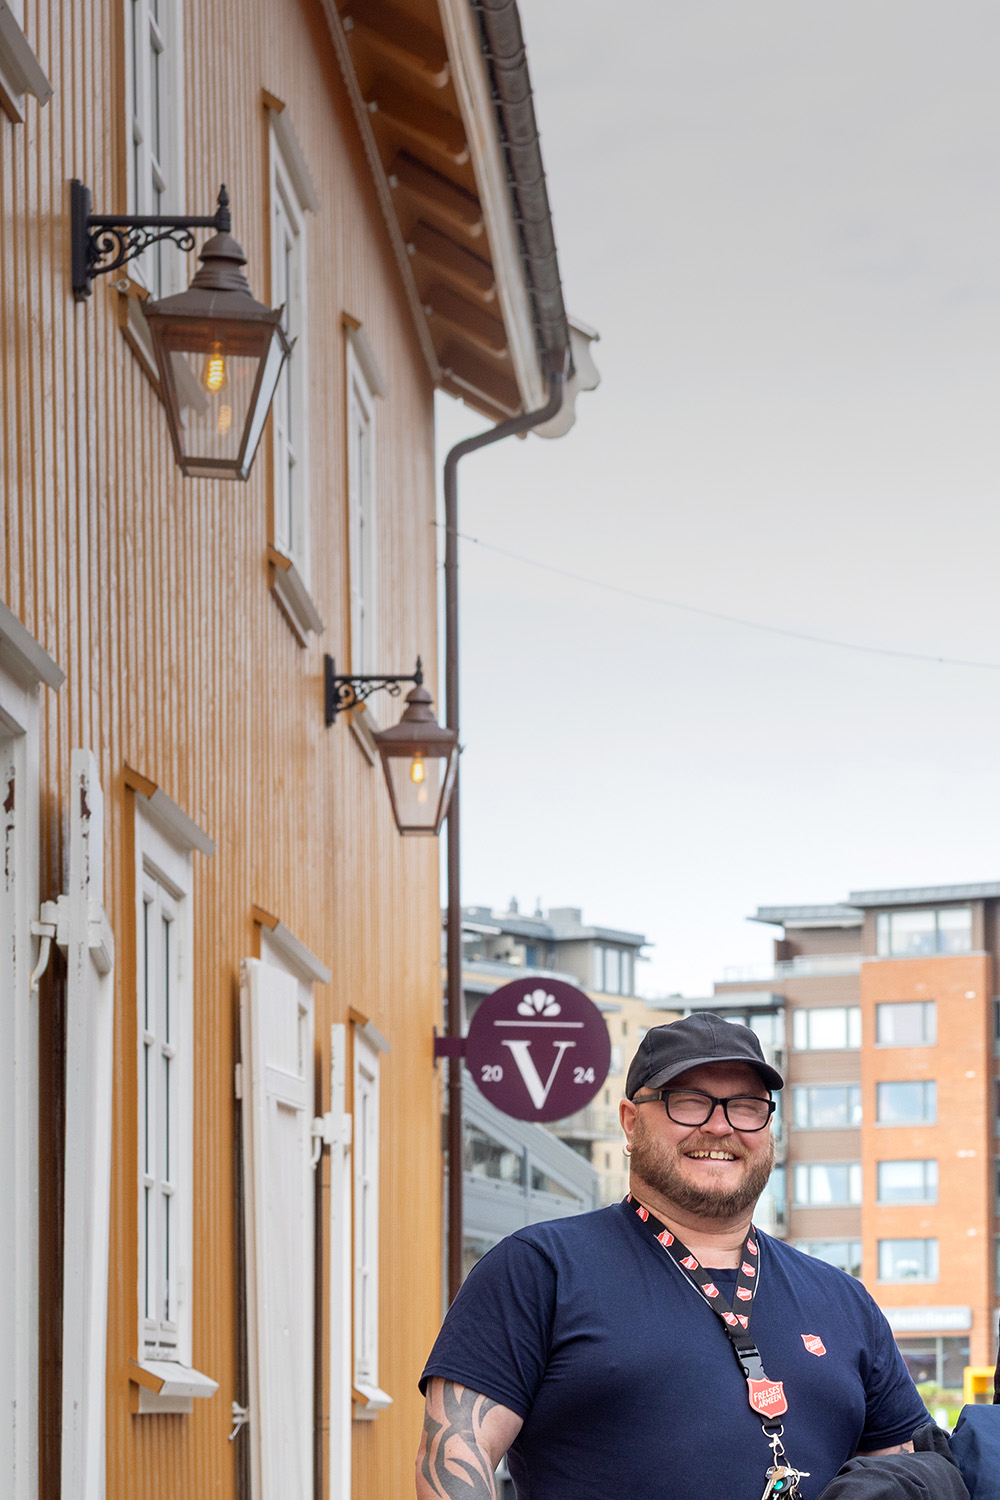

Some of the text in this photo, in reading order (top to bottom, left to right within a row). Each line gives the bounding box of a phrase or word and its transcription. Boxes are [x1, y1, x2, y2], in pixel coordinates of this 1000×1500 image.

[481, 1065, 595, 1084] 20 24
[501, 1039, 577, 1110] V
[753, 1385, 780, 1402] FRELSES
[758, 1393, 782, 1408] ARMEEN
